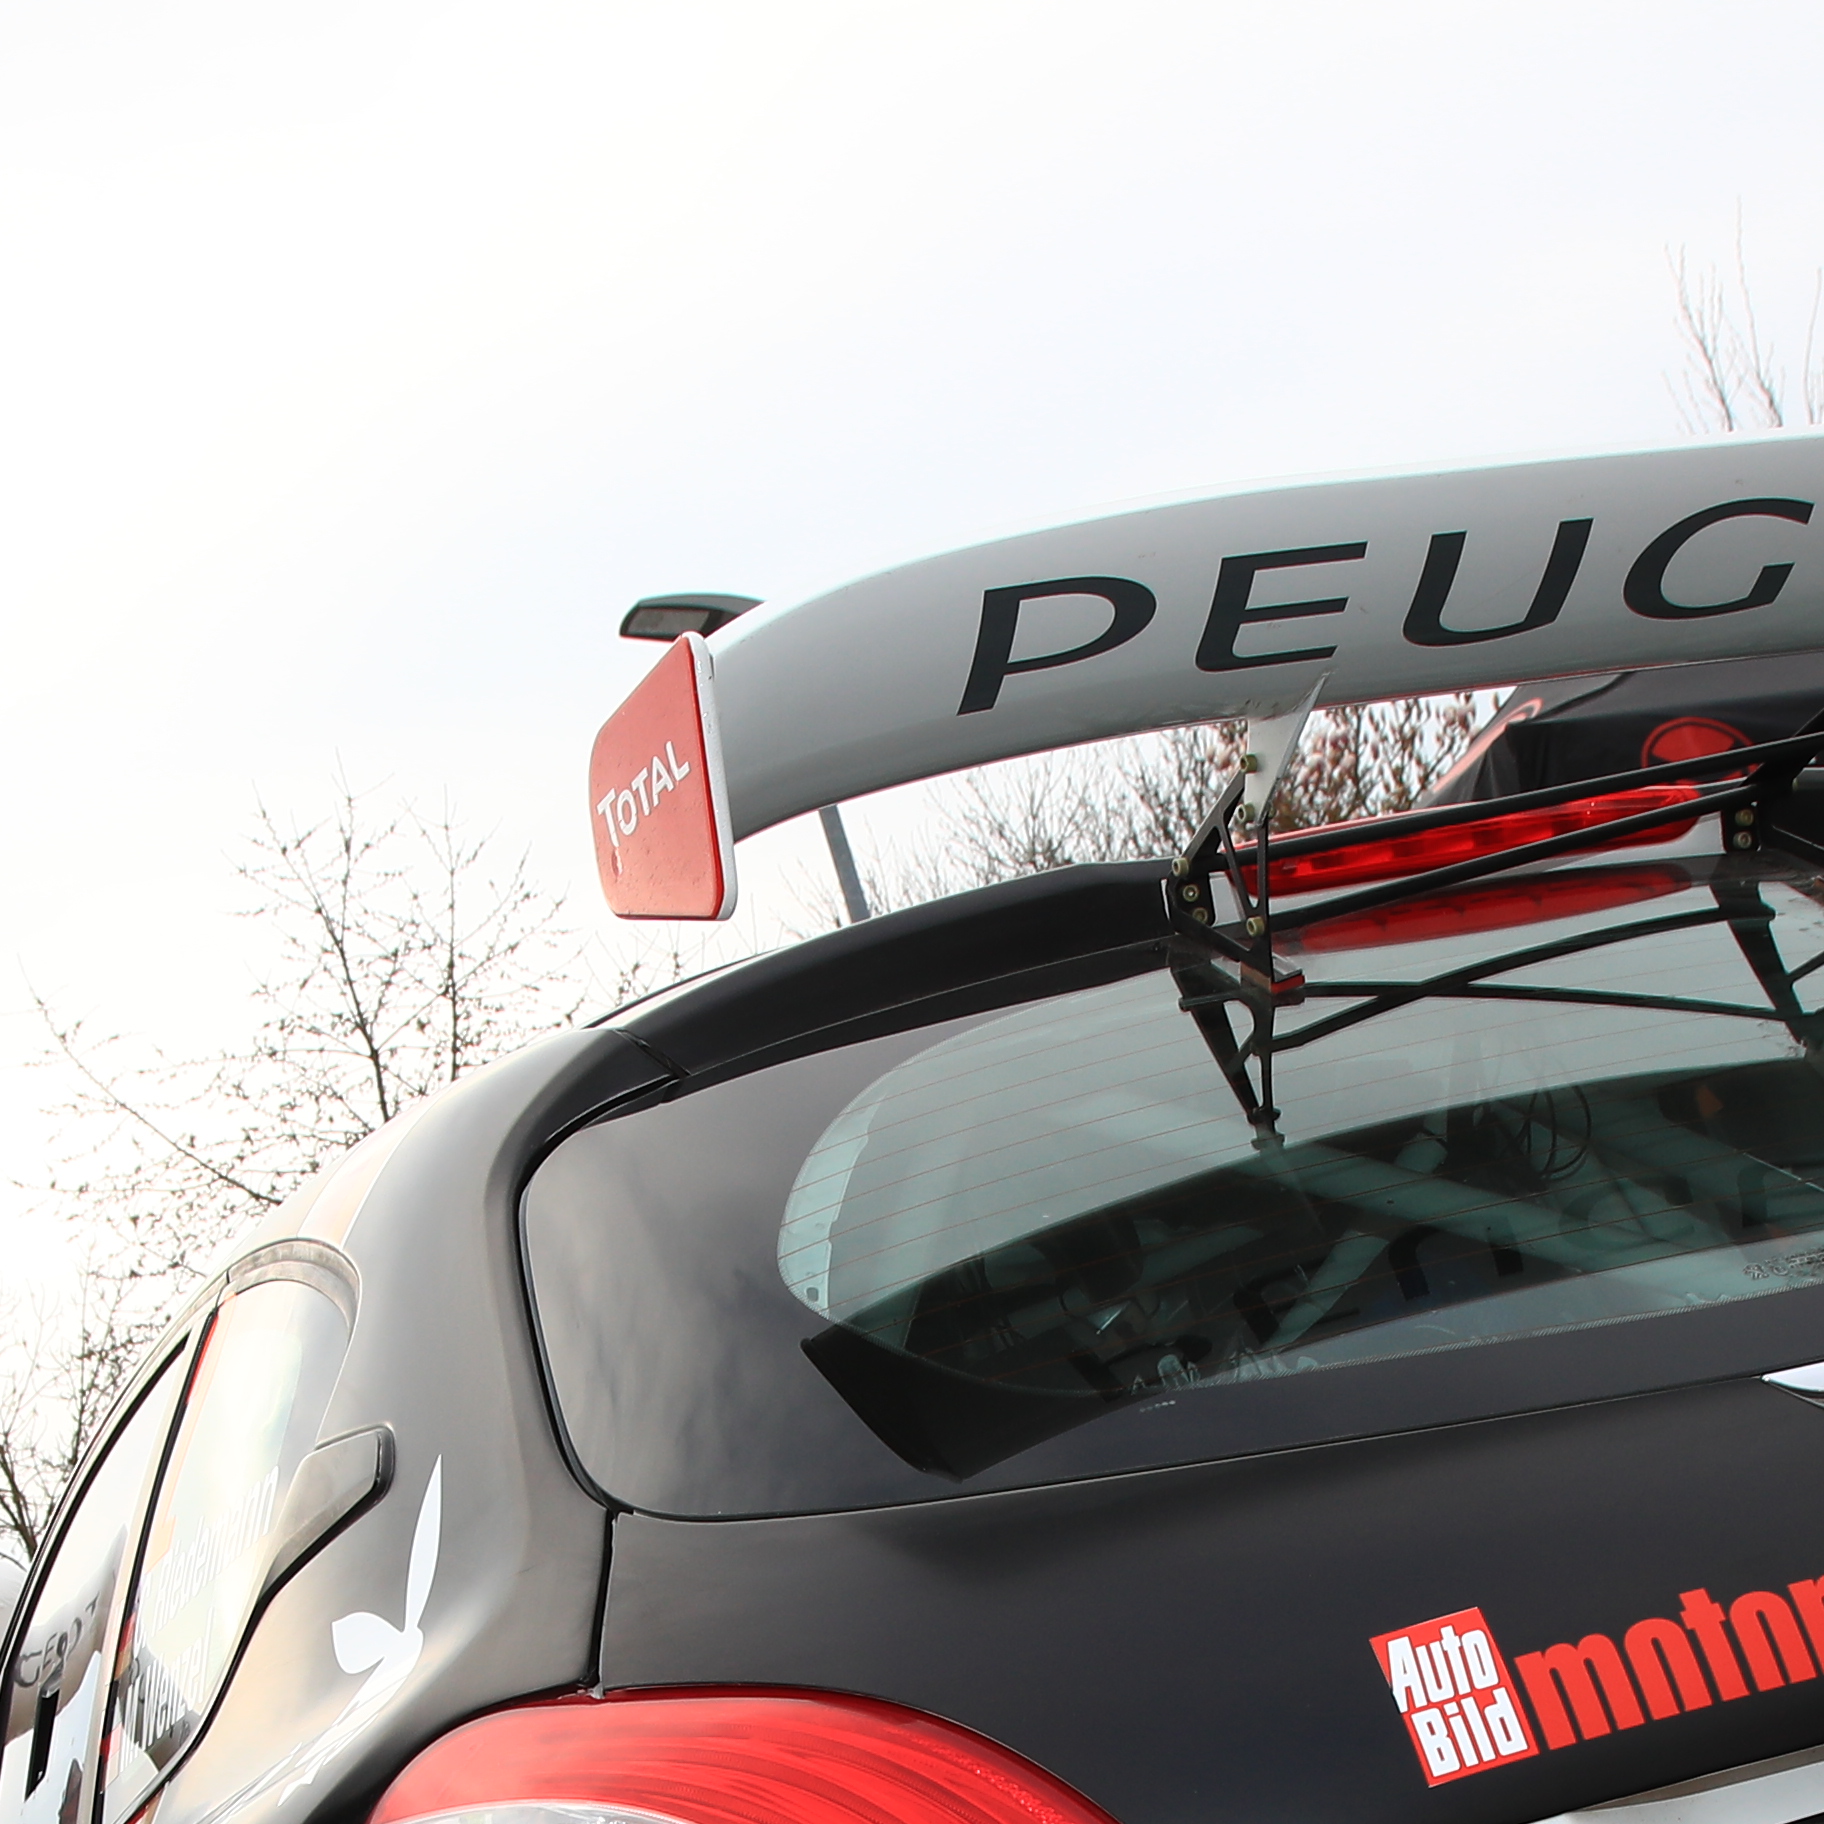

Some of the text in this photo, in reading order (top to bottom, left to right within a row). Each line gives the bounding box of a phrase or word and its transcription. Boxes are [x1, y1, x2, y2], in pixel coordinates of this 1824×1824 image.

[596, 741, 690, 847] TOTAL
[1387, 1625, 1500, 1712] Auto
[1409, 1686, 1529, 1778] Bild
